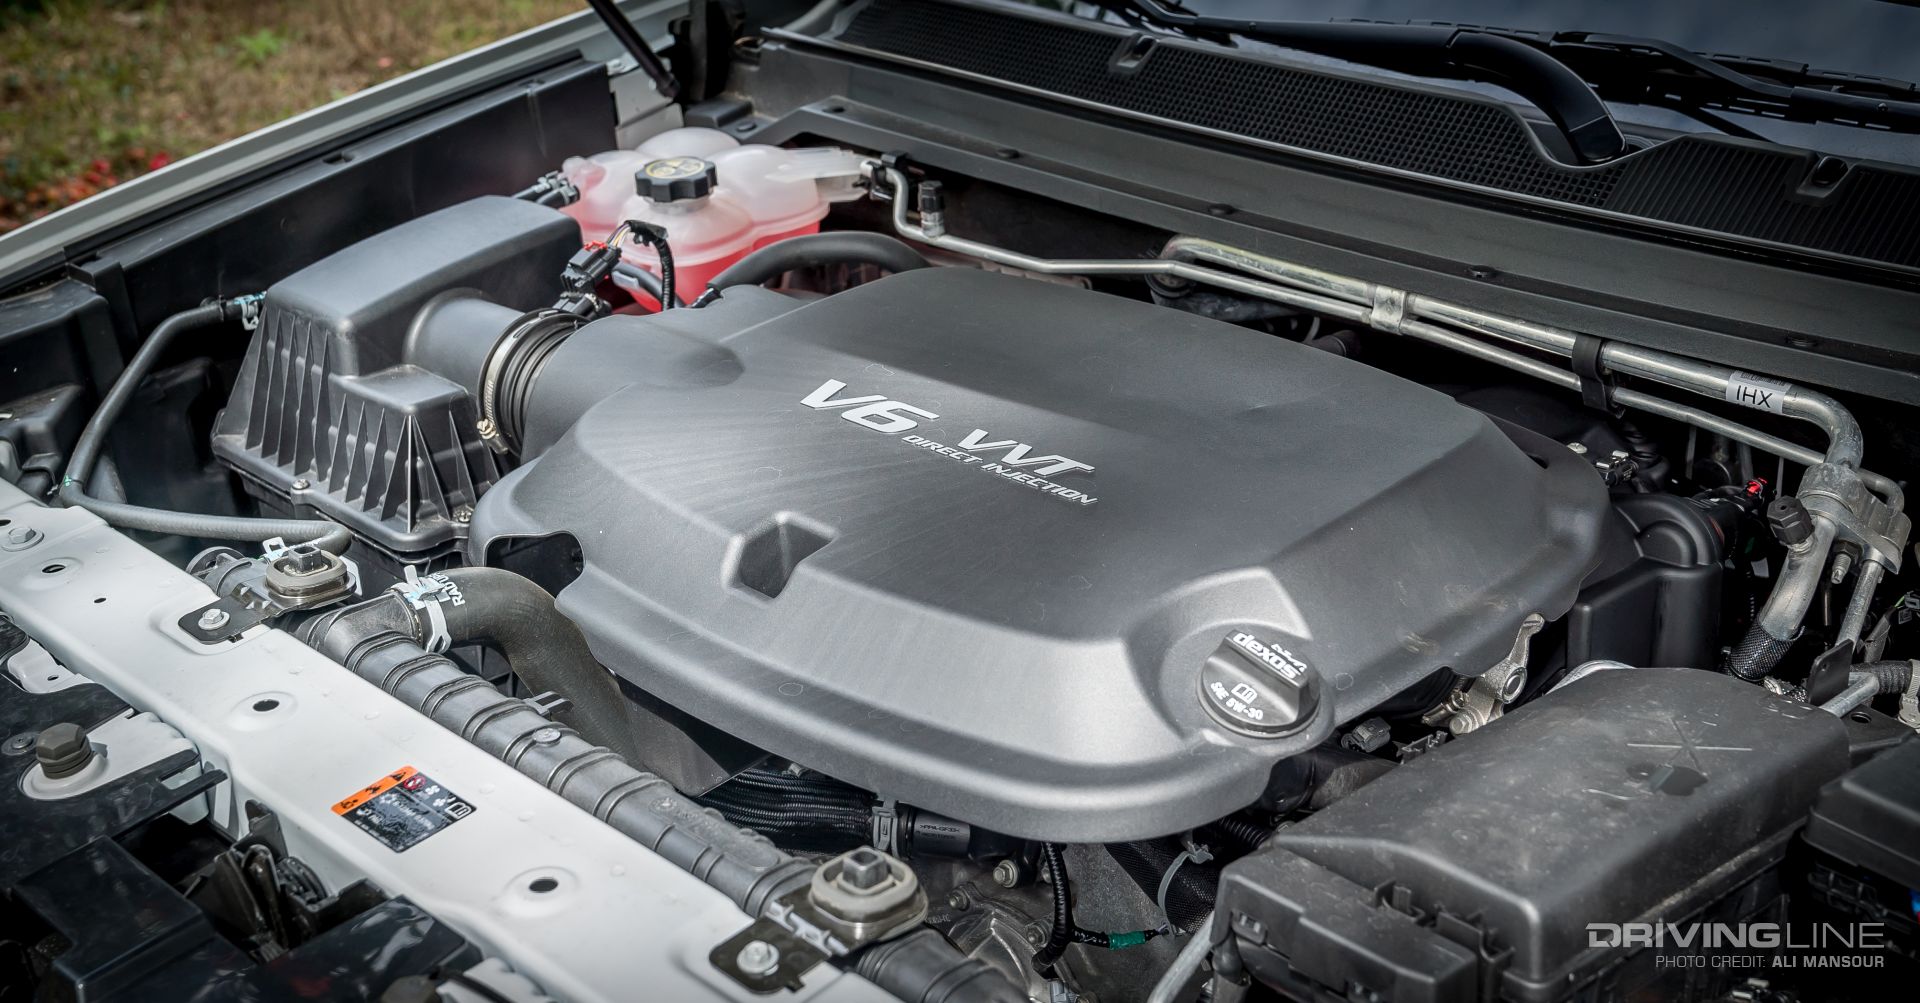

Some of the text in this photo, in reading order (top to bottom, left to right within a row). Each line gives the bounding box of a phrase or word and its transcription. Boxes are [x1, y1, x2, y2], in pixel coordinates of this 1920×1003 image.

[1737, 385, 1772, 408] IHX
[800, 379, 1095, 476] V6 VVT
[902, 434, 1097, 505] DIRECT INJECTION
[444, 582, 466, 606] RAD
[1233, 632, 1301, 679] dexos
[1211, 681, 1263, 720] SAE 5W-30
